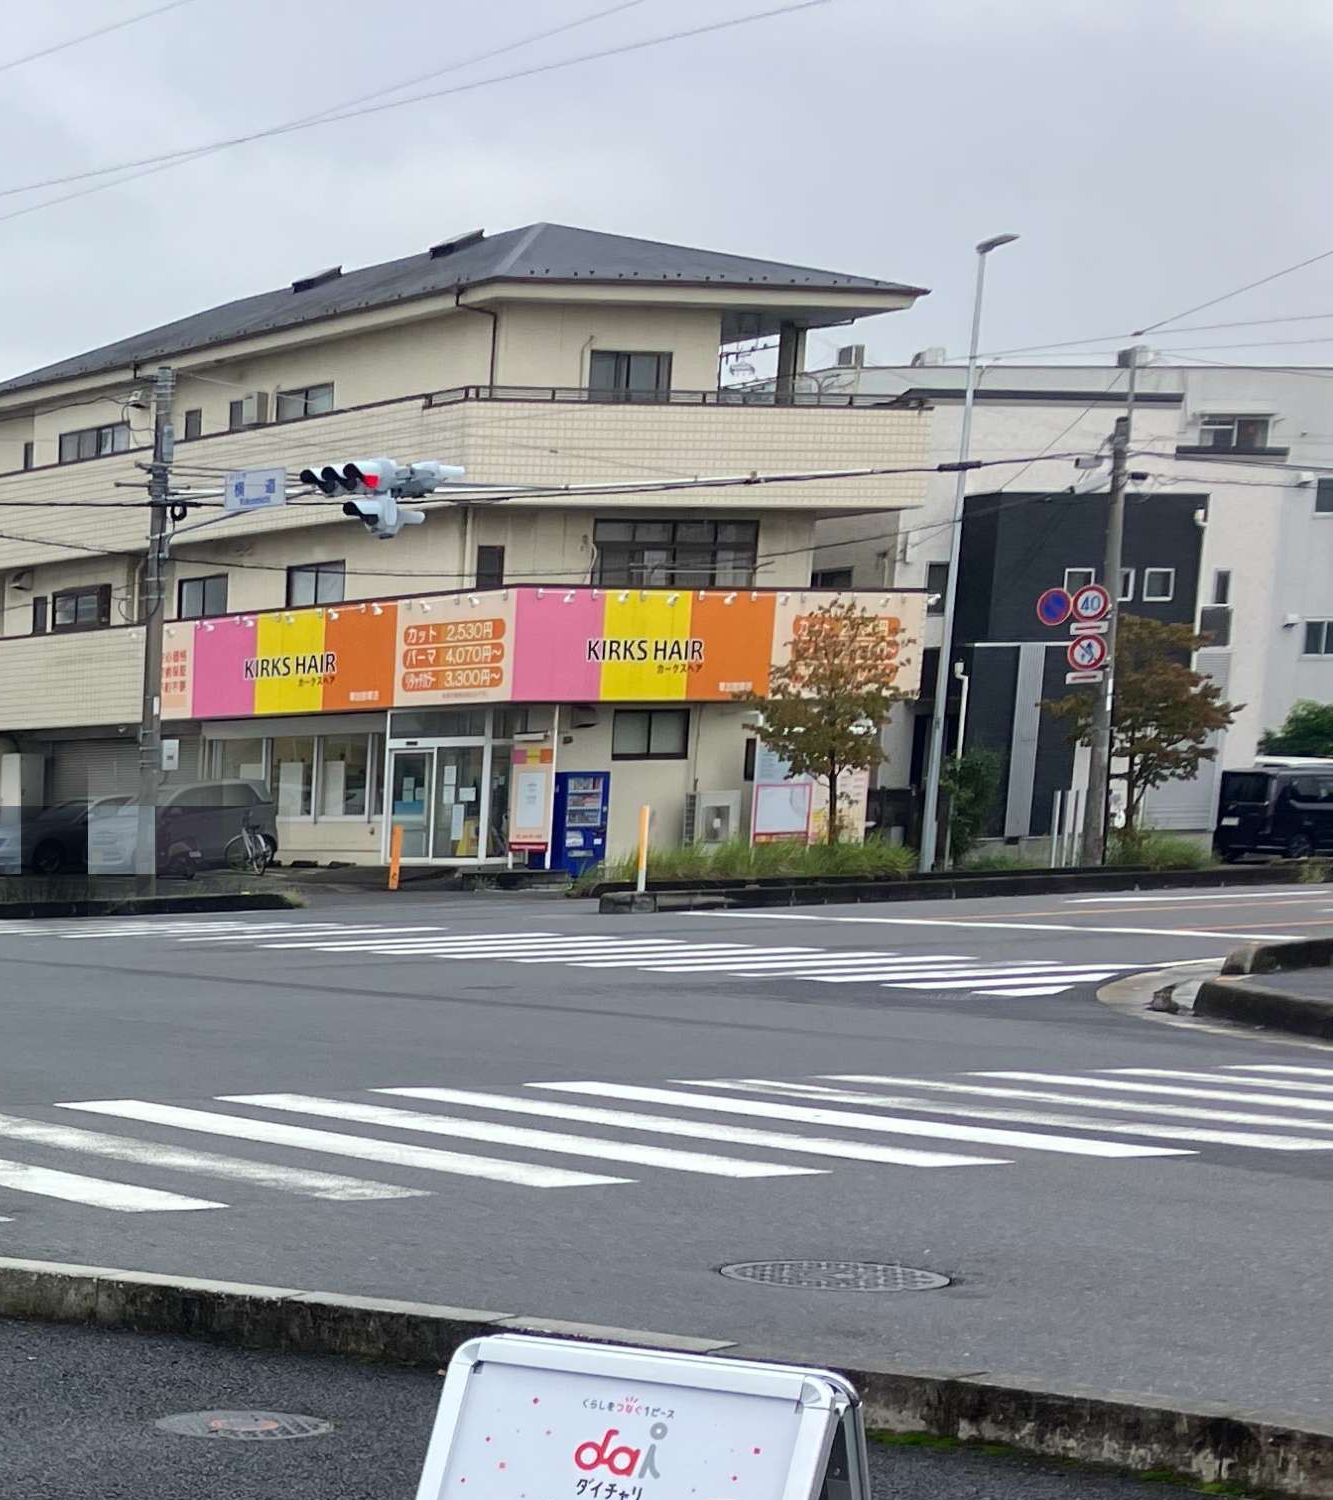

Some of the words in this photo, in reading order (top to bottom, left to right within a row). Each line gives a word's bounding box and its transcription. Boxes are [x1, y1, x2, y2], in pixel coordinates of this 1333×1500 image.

[1080, 596, 1102, 611] 40
[407, 625, 437, 644] カット
[445, 621, 493, 641] 2,530円
[406, 648, 437, 666] パーマ
[587, 639, 648, 661] KIRKS
[654, 639, 703, 661] HAIR
[244, 656, 291, 678] KIRKS
[295, 653, 336, 675] HAIR
[656, 664, 703, 674] カークスヘア
[297, 676, 336, 687] カークスヘア
